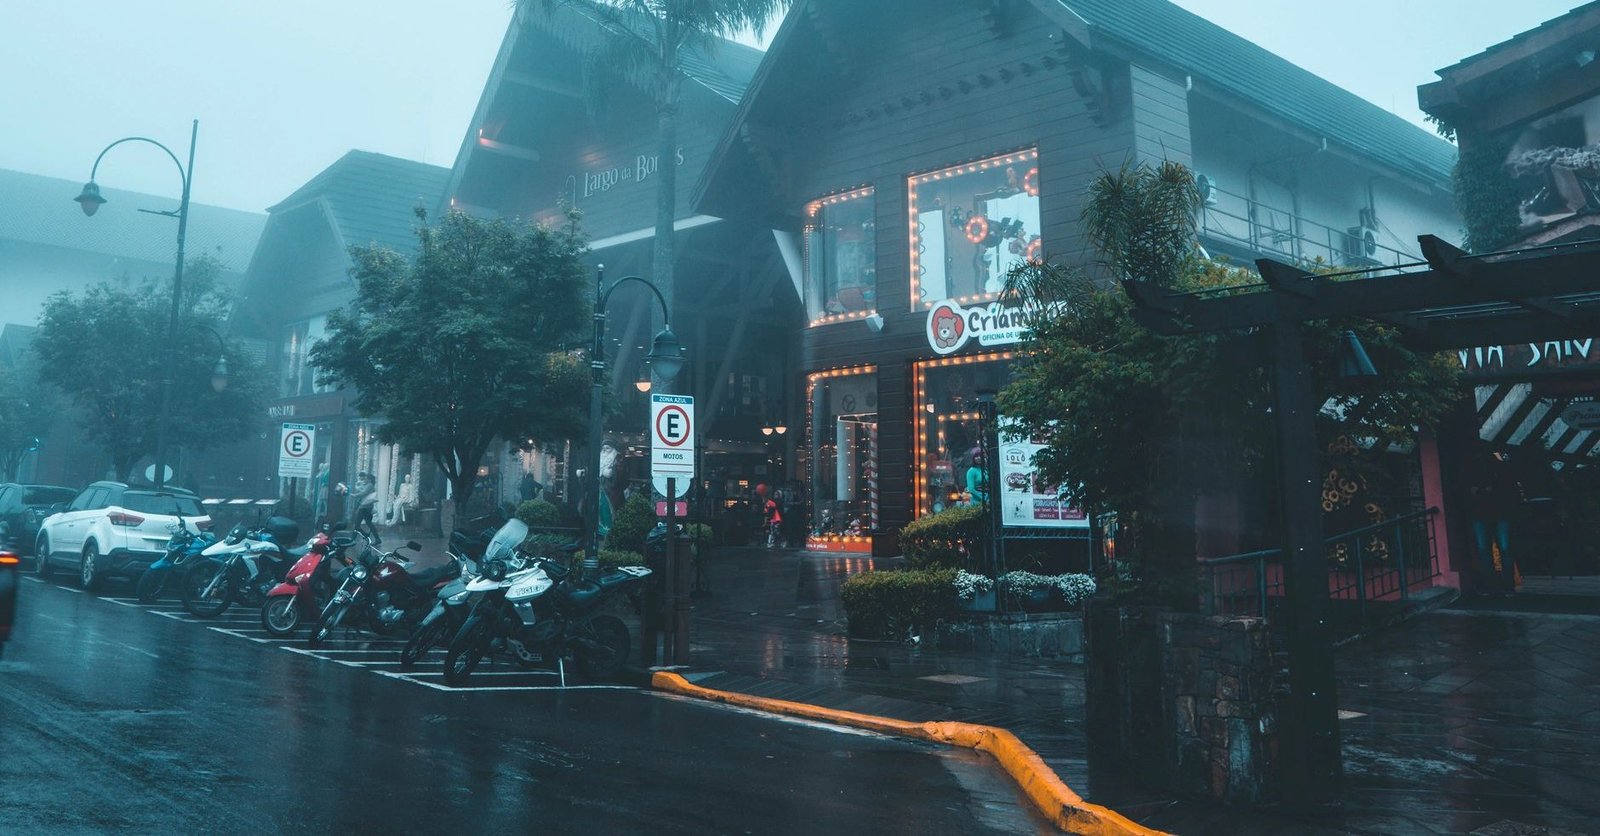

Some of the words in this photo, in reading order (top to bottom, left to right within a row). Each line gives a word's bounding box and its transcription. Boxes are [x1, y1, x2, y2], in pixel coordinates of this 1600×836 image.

[583, 168, 618, 197] Largo
[621, 167, 632, 180] da
[982, 332, 1005, 341] OFICINA
[1006, 331, 1014, 339] DE
[668, 414, 679, 437] E
[292, 436, 302, 451] E
